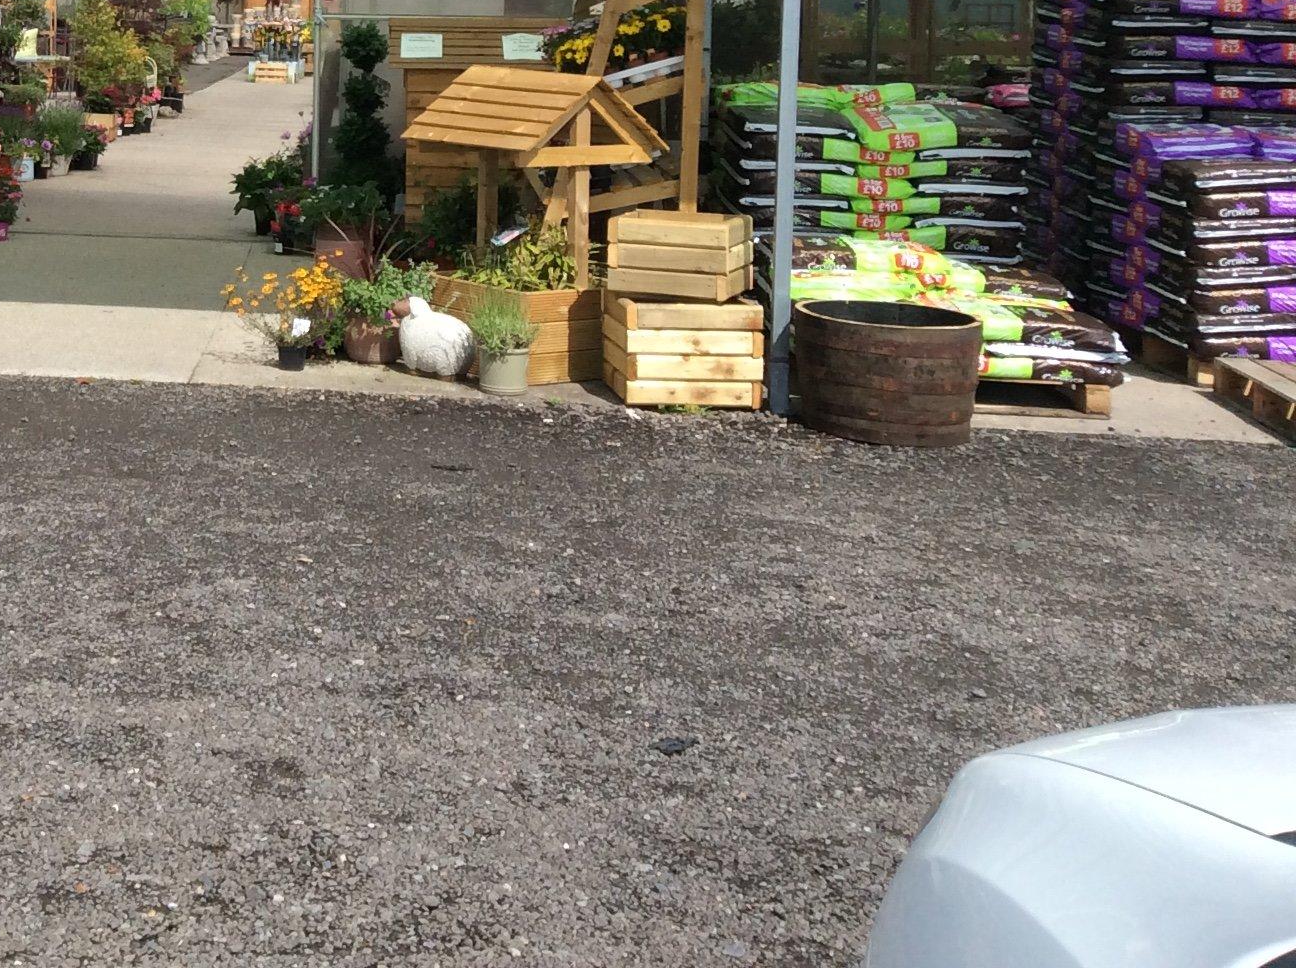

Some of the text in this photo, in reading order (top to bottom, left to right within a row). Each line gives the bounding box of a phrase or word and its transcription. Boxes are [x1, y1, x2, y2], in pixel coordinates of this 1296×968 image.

[895, 138, 916, 149] £10
[865, 151, 885, 161] £10
[884, 166, 905, 177] £10
[863, 185, 884, 196] £10
[878, 202, 898, 212] £10
[1218, 206, 1261, 218] Growise
[862, 218, 882, 228] £10
[1217, 256, 1260, 267] Growise
[1219, 303, 1262, 315] Growise
